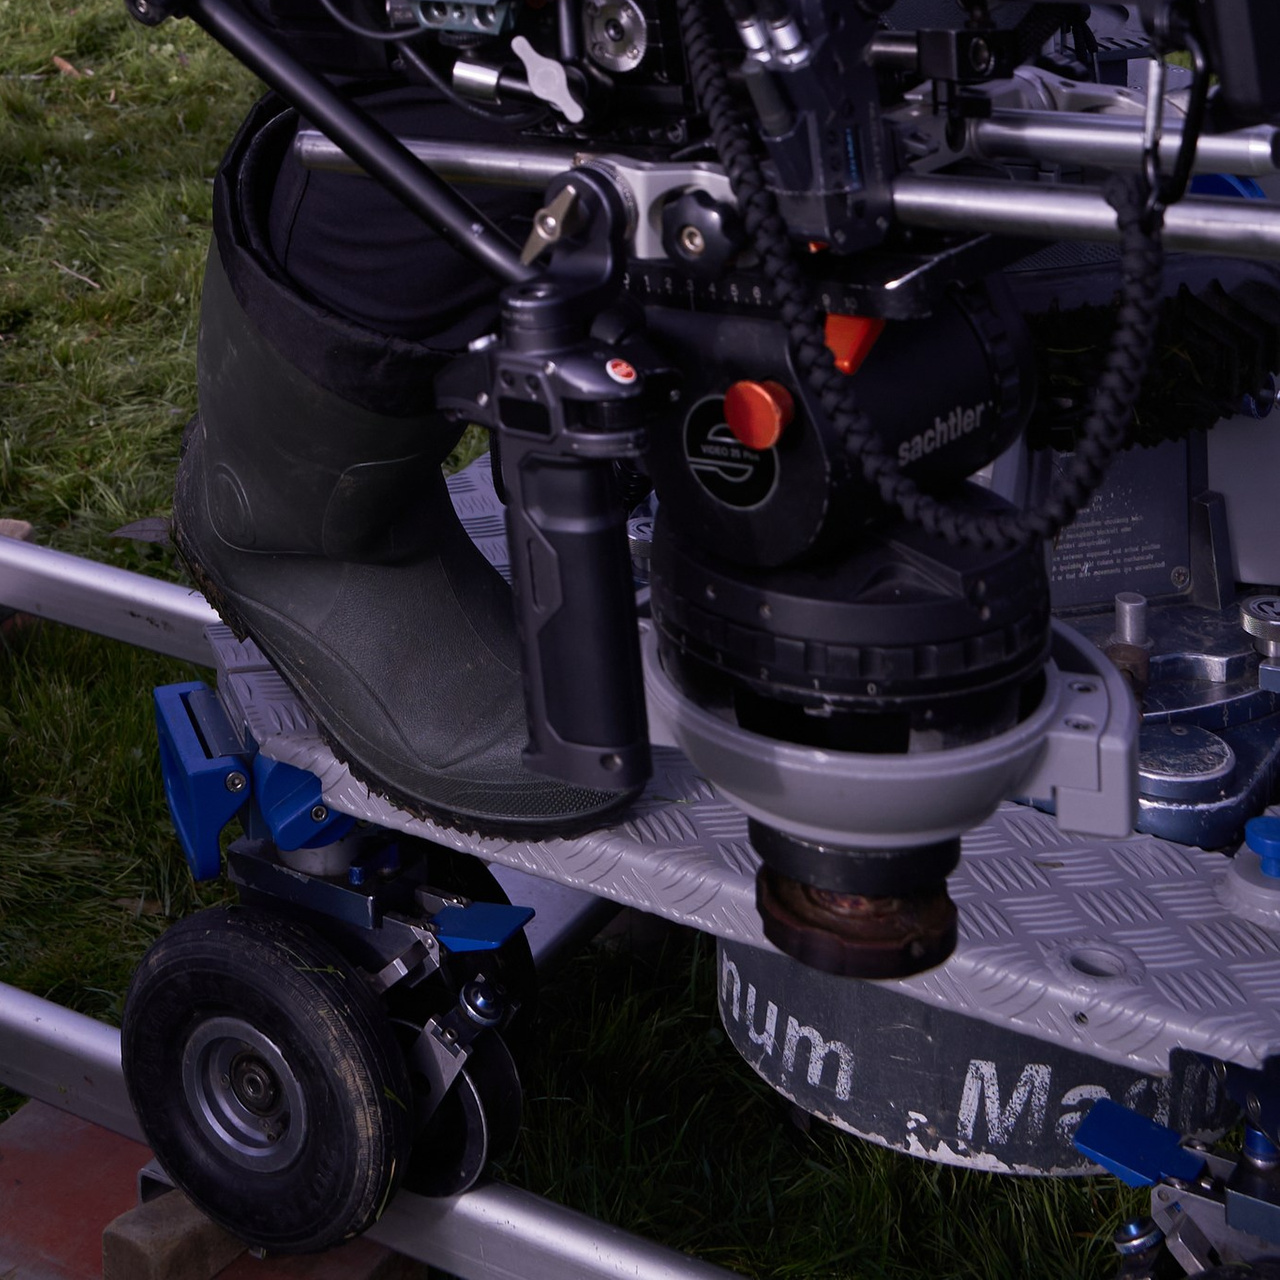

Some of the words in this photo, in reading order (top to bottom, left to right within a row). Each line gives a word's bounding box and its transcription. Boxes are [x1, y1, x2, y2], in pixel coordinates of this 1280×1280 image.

[897, 402, 986, 468] sachtler
[700, 443, 729, 458] VIDEO
[866, 681, 876, 695] 0
